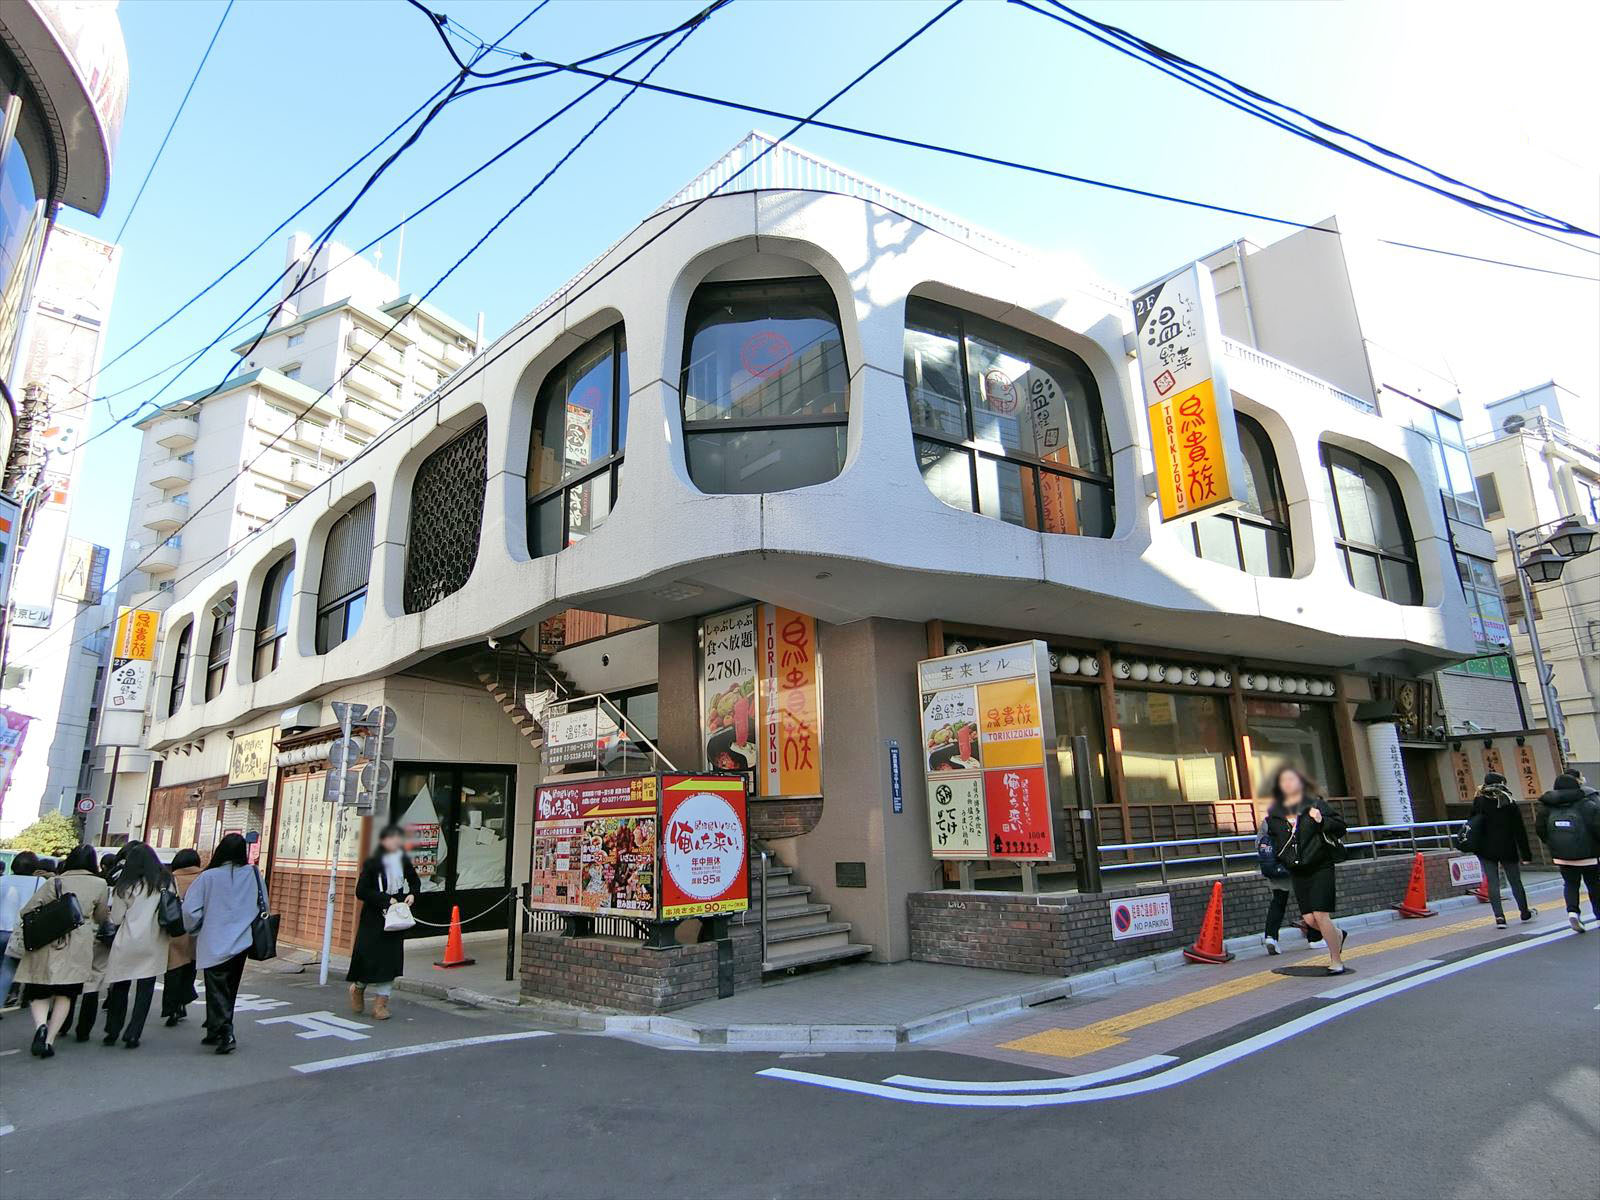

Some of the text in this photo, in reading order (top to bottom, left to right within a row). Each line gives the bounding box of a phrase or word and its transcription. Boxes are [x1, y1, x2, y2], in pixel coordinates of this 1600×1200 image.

[1136, 294, 1156, 316] 2F
[1148, 305, 1193, 374] 温野菜
[1163, 405, 1185, 505] TORIKIZOKU
[1178, 393, 1217, 504] 鳥貴族
[132, 613, 151, 658] 鳥貴族
[706, 613, 754, 637] しゃぶしゃぶ
[706, 629, 754, 657] 食べ放題
[114, 658, 127, 668] 2F
[940, 658, 1011, 681] 宝来ビル
[766, 622, 778, 766] TORIKIZOKU
[923, 694, 934, 704] 2F
[930, 700, 967, 721] 温野菜
[986, 703, 1033, 729] 鳥貴族
[988, 729, 1034, 741] TORIKIZOKU
[691, 856, 721, 867] 年中無休
[1134, 918, 1170, 931] NO PARKING
